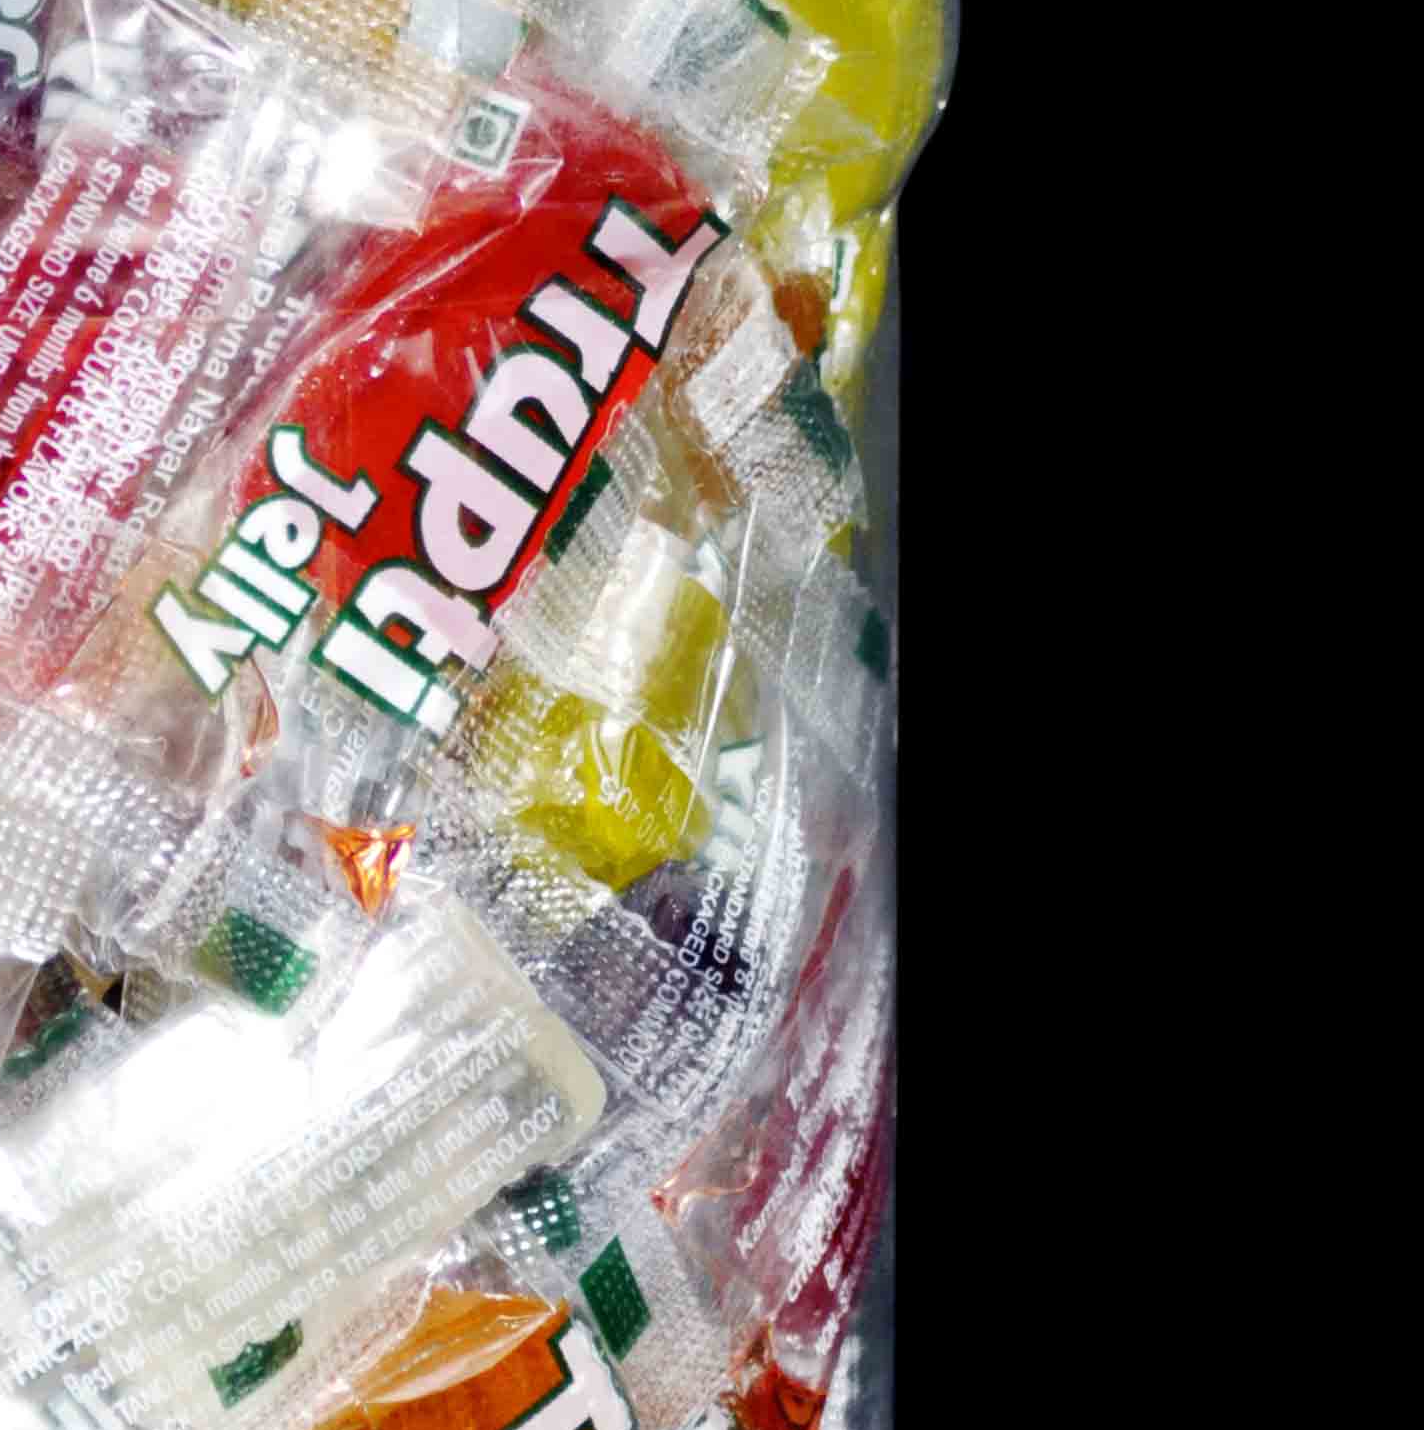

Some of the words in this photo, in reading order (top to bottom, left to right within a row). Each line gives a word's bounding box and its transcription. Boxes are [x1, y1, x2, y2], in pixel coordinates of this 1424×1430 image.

[33, 153, 125, 280] STANDARD
[120, 160, 173, 220] Best
[5, 271, 57, 330] SIZE
[22, 301, 94, 390] months
[70, 280, 108, 313] 6
[140, 380, 225, 493] Nagar
[308, 193, 732, 739] Trupti
[149, 423, 383, 699] Jelly
